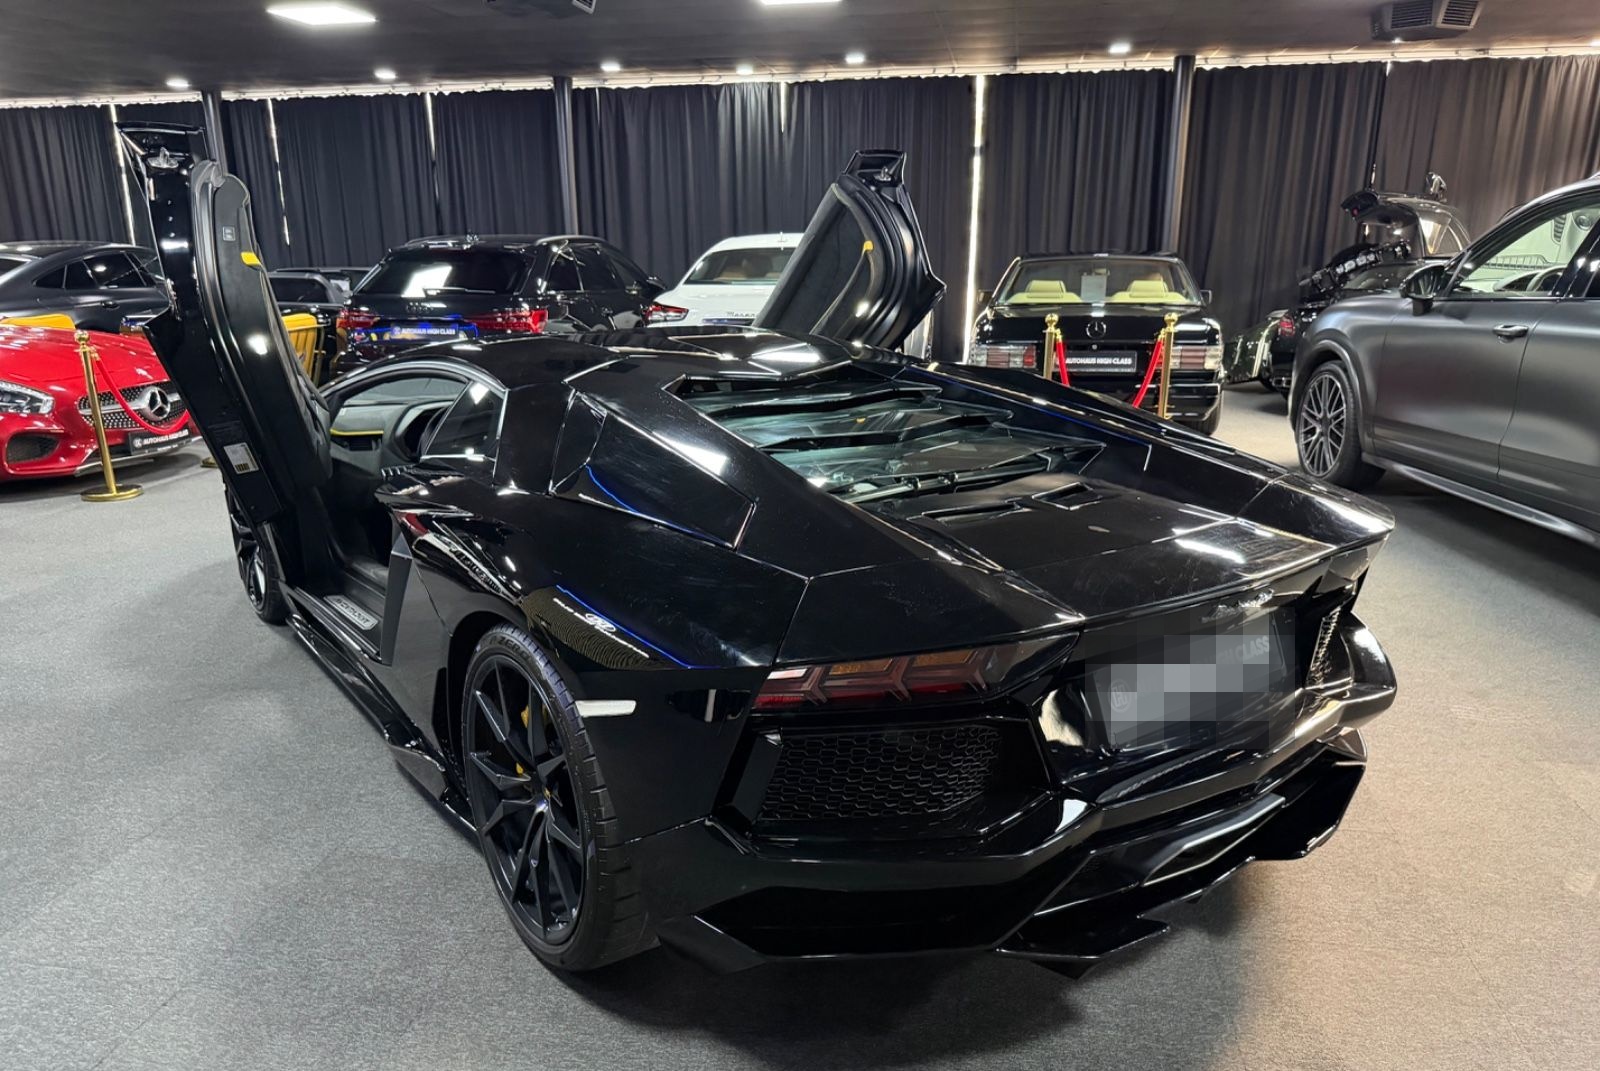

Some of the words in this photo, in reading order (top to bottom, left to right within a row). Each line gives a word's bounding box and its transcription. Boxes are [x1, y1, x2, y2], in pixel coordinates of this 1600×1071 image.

[401, 327, 426, 335] AUTOHAUS
[427, 327, 439, 335] HIGH
[439, 327, 456, 335] CLASS
[1065, 357, 1096, 365] AUTOHAUS
[1097, 357, 1112, 365] HIGH
[1112, 357, 1132, 365] CLASS
[143, 434, 169, 445] AUTOHAUS
[1234, 635, 1270, 662] CLASS
